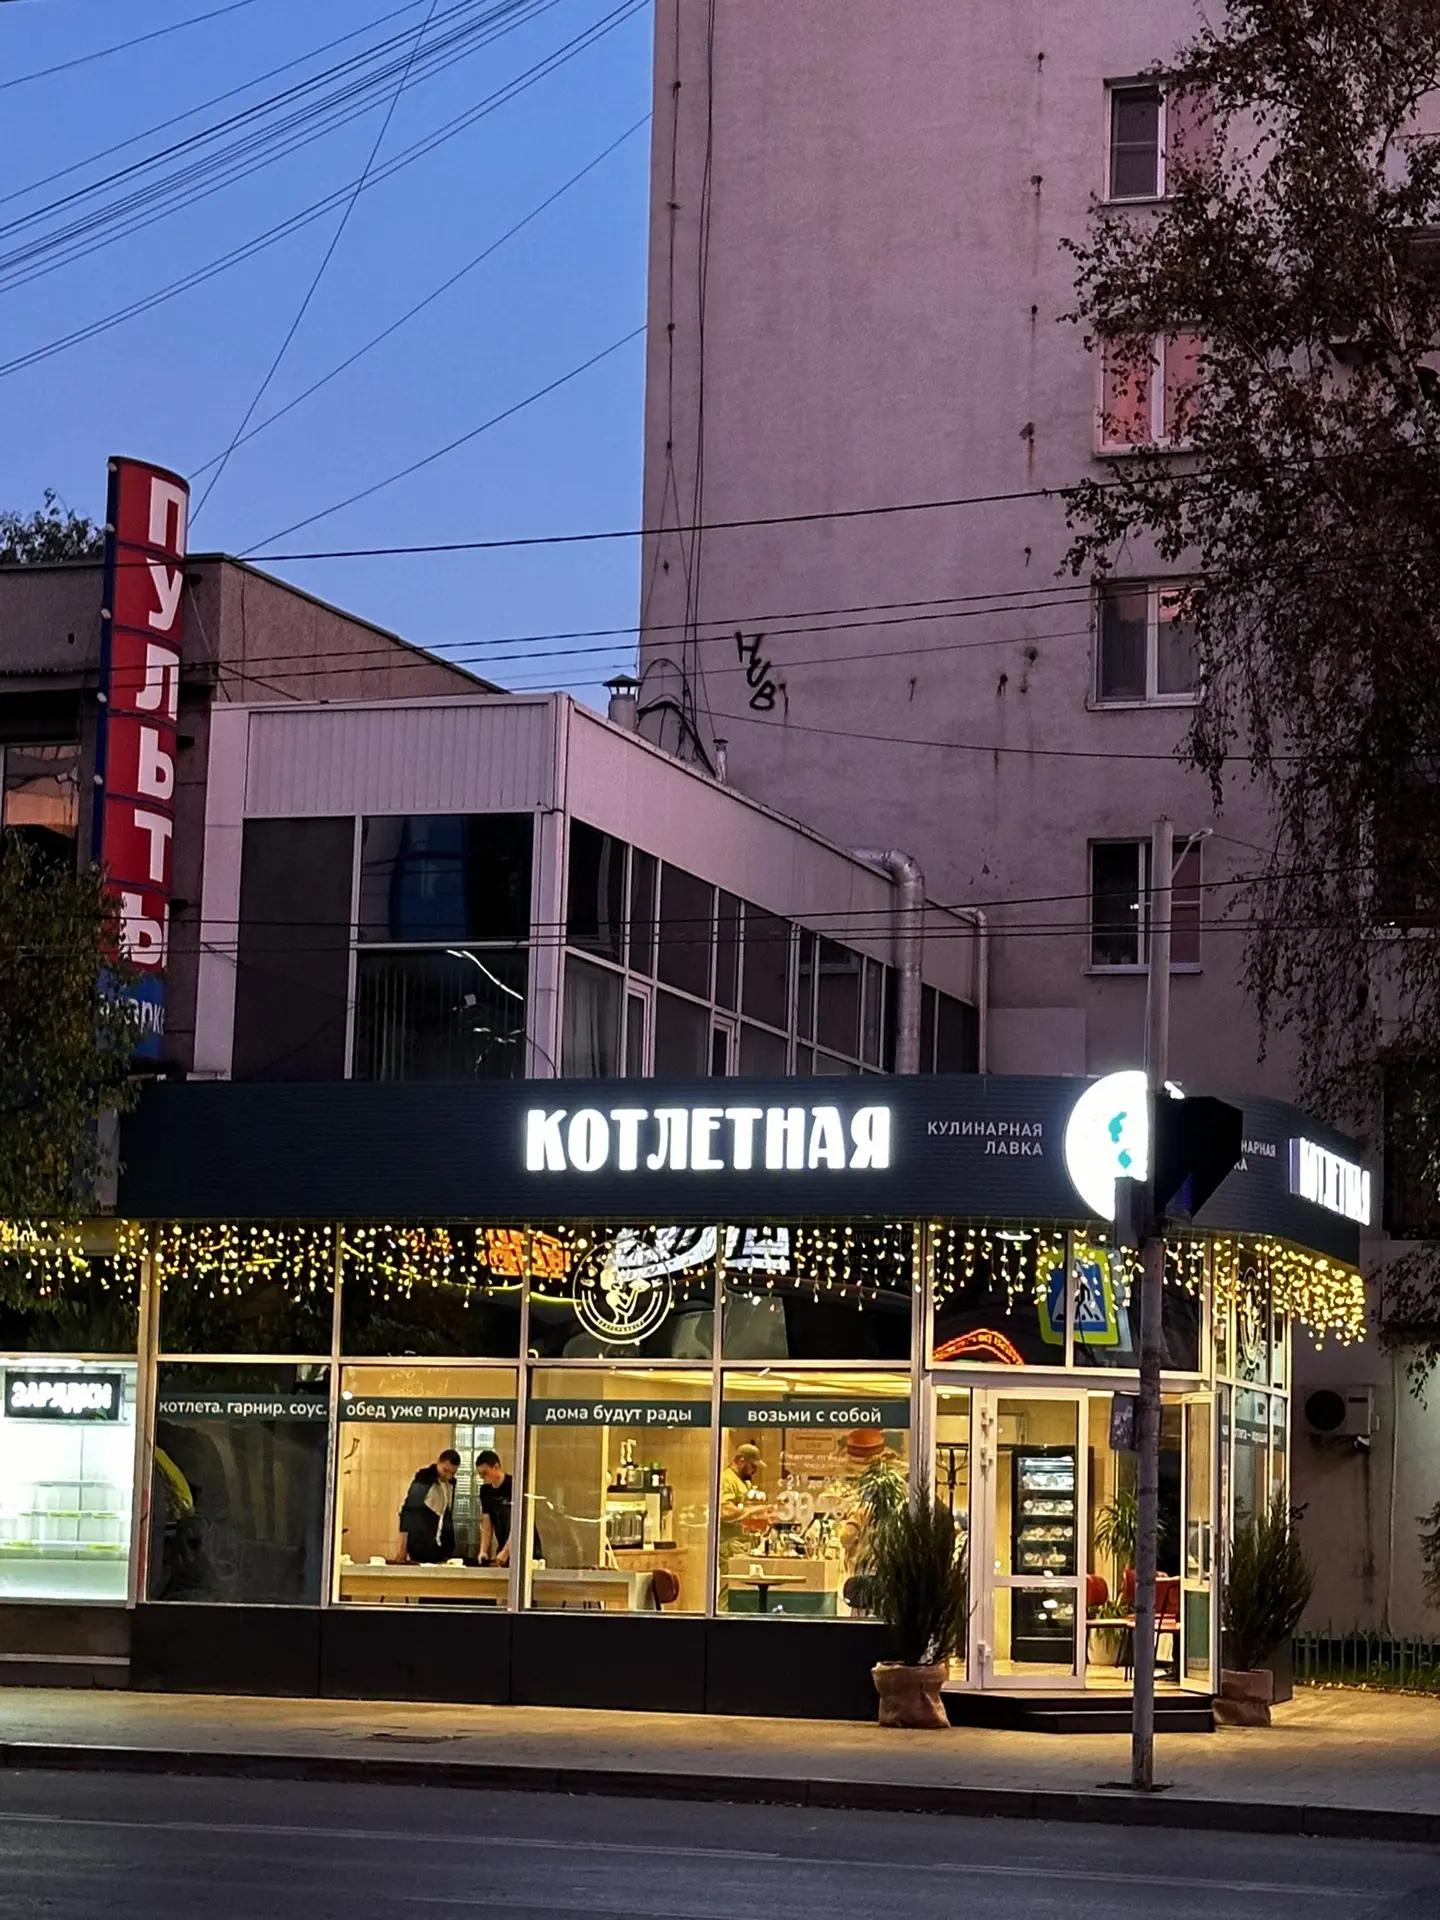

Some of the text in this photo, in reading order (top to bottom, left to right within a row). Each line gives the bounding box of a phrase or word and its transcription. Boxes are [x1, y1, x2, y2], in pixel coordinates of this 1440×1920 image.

[118, 476, 188, 970] ПУЛЬТЫ
[928, 1121, 1043, 1137] КУЛИНАРНАЯ
[526, 1106, 891, 1172] КОТЛЕТНАЯ
[985, 1141, 1043, 1156] ЛАВКА
[1241, 1139, 1277, 1158] НАРНАЯ
[159, 1401, 327, 1418] котлета. гарнир. соус.
[346, 1401, 511, 1421] обед уже придуман
[545, 1404, 692, 1423] дома будут рады
[747, 1407, 882, 1423] возьми с собой
